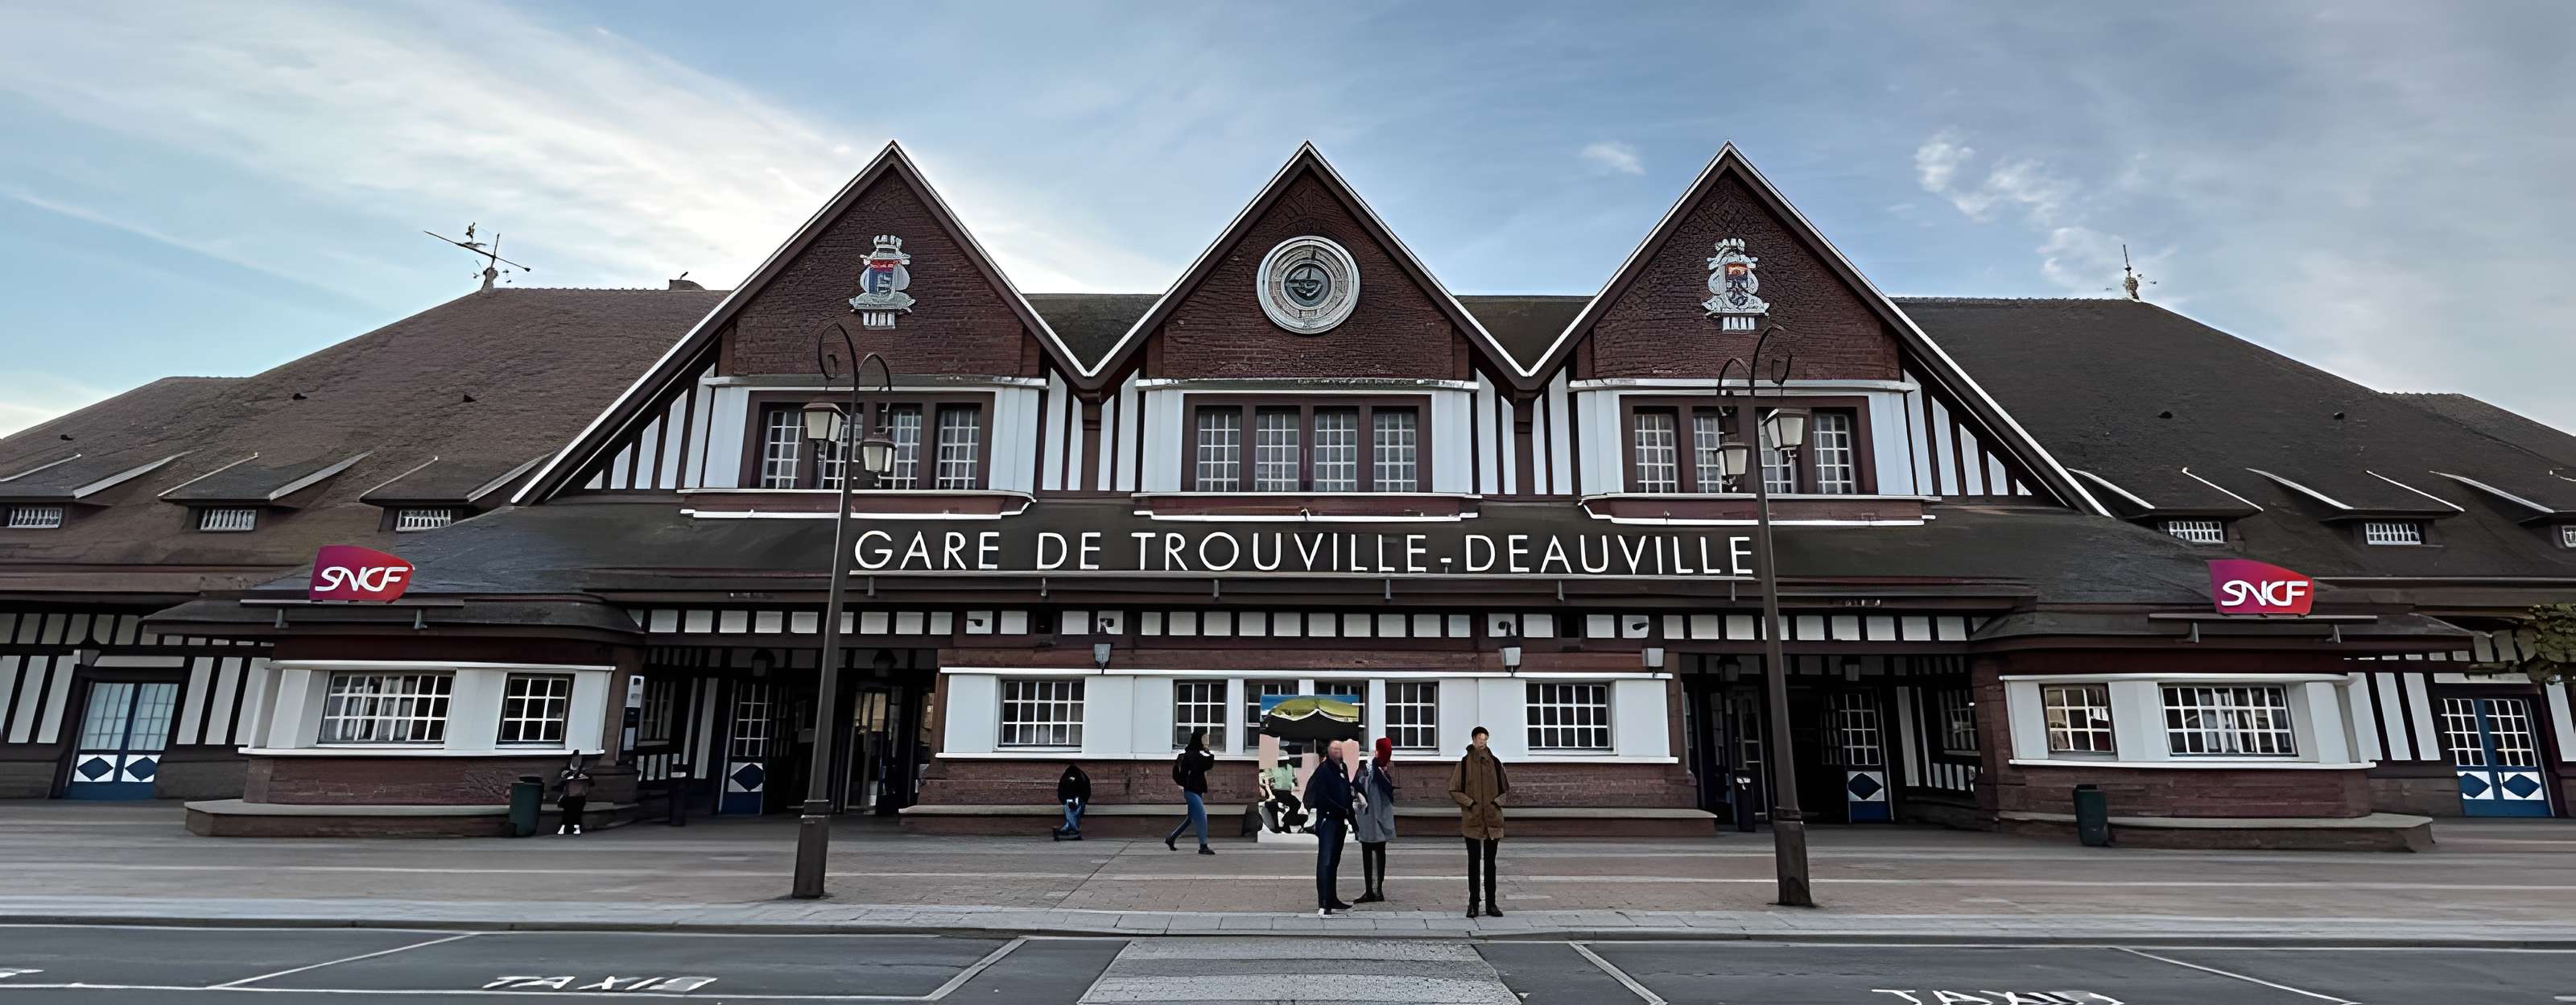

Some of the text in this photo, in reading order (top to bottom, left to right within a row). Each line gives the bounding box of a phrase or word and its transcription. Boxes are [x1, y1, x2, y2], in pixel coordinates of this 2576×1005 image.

[854, 531, 1754, 576] GARE DE TROUVILLE-DEAUVILLE
[315, 566, 409, 592] SNCF
[2221, 580, 2309, 606] SNCF
